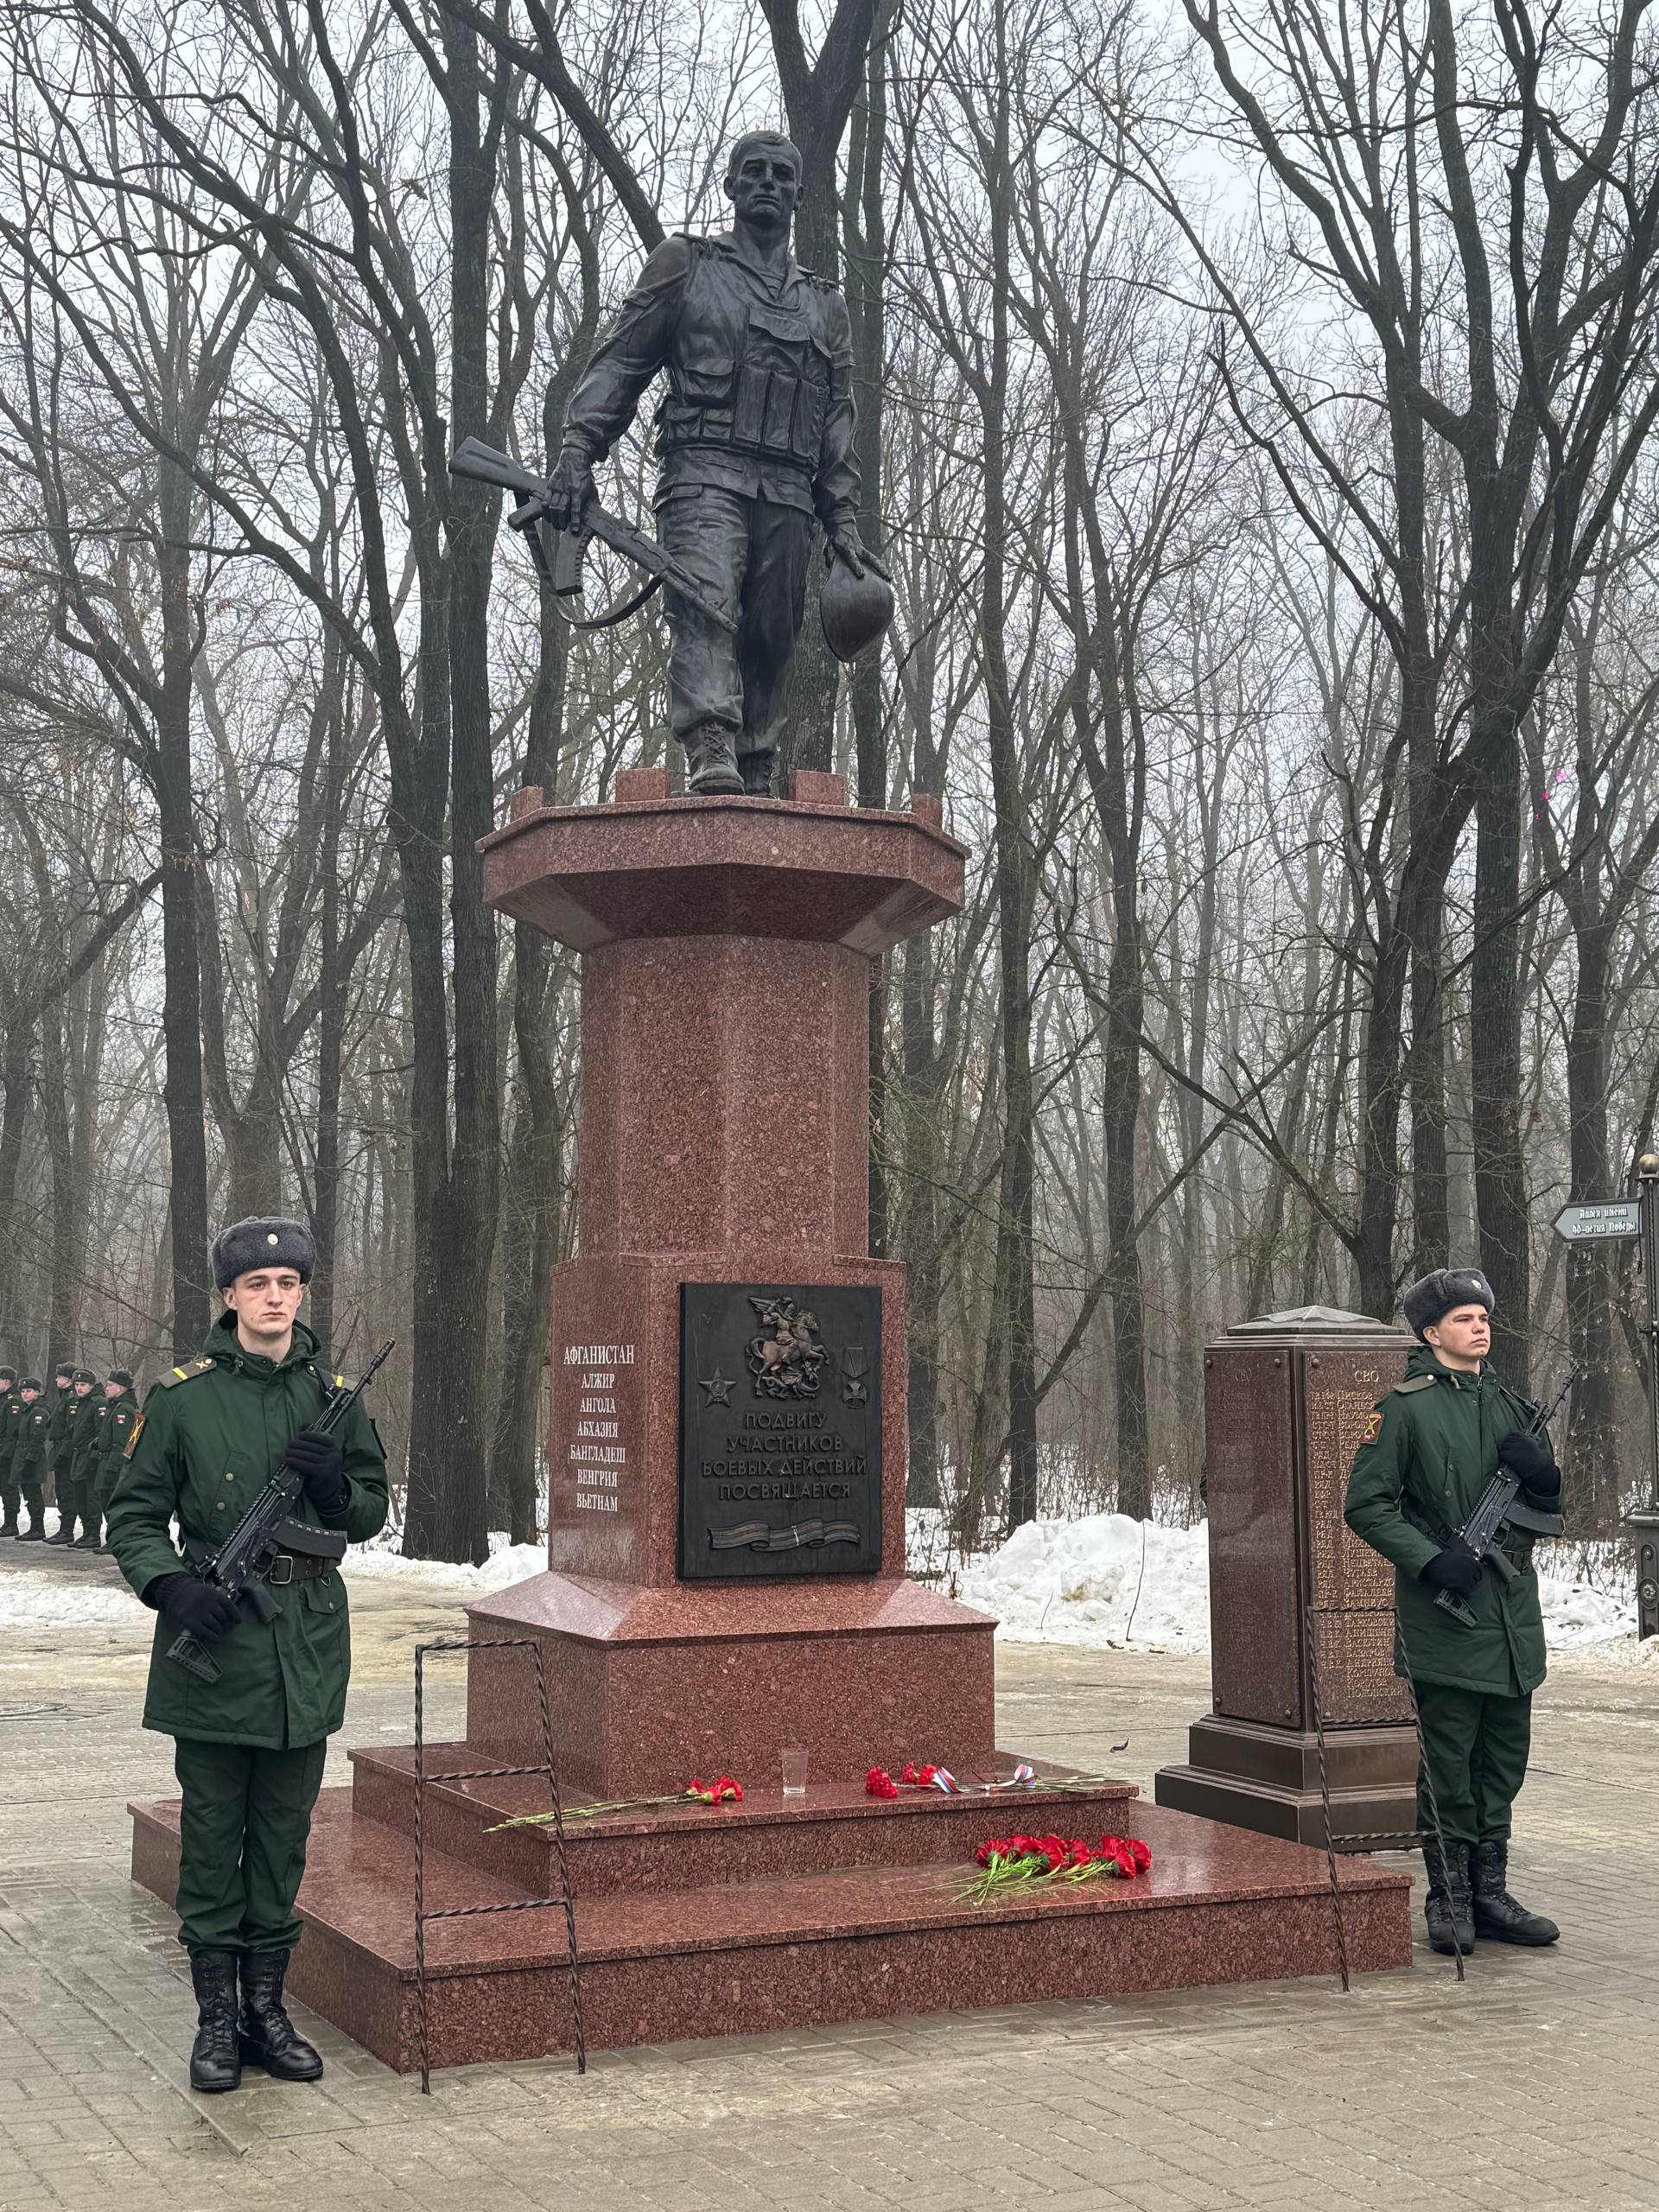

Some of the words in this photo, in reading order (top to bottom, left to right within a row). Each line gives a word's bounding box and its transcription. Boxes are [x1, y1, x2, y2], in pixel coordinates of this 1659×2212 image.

[563, 1344, 635, 1364] АФГАНИСТАН
[581, 1373, 615, 1389] АЛЖИР
[1354, 1370, 1380, 1382] СВО
[580, 1397, 617, 1413] АНГОЛА
[577, 1421, 619, 1438] АБХАЗИЯ
[746, 1412, 826, 1430] ПОДВИГУ
[727, 1435, 843, 1452] УЧАСТНИКОВ
[570, 1445, 626, 1465] БАНГЛАДЕШ
[702, 1459, 773, 1477] БОЕВЫХ
[779, 1455, 867, 1477] ДЕЙСТВИЙ
[577, 1469, 619, 1487] ВЕНГРИЯ
[719, 1482, 851, 1501] ПОСВЯЩАЕТСЯ
[576, 1493, 619, 1512] ВЬЕТНАМ
